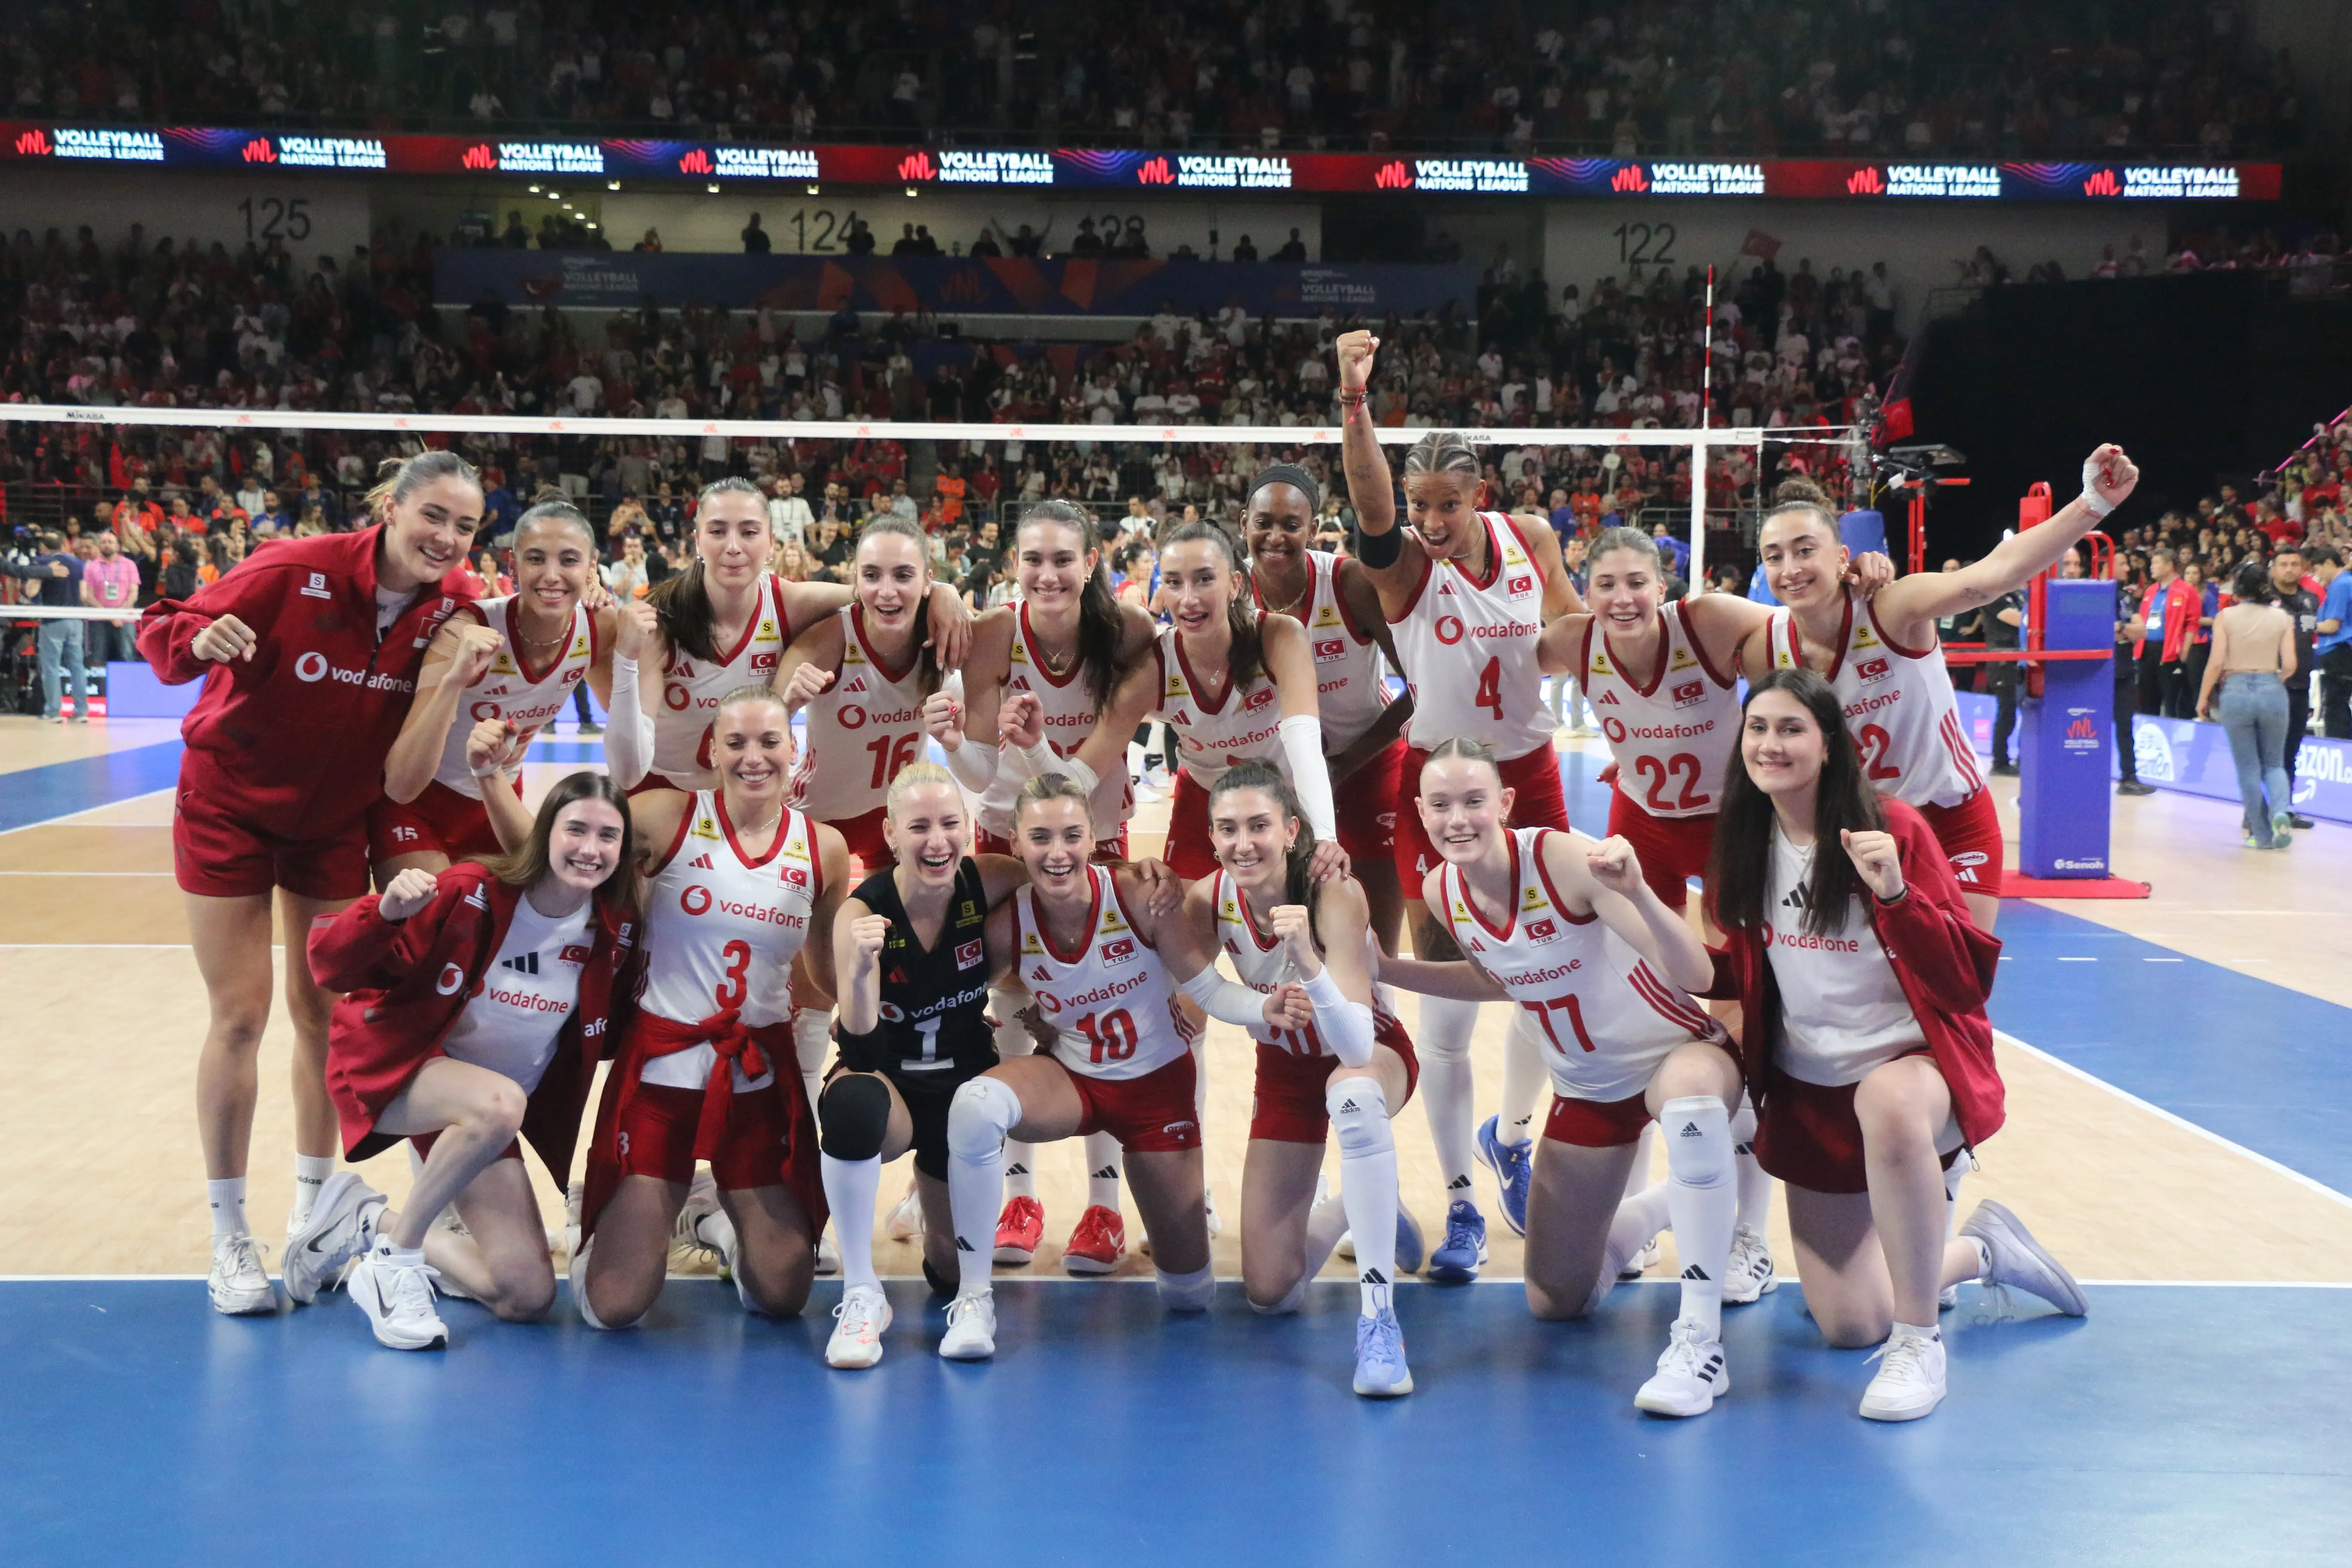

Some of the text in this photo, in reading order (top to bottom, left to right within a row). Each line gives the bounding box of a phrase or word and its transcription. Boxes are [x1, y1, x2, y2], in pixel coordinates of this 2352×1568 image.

[55, 129, 163, 148] VOLLEYBALL
[55, 145, 164, 160] NATIONS LEAGUE
[279, 138, 385, 156] VOLLEYBALL
[499, 144, 603, 161] VOLLEYBALL
[279, 152, 386, 168] NATIONS LEAGUE
[499, 158, 603, 172] NATIONS LEAGUE
[716, 149, 818, 166] VOLLEYBALL
[940, 152, 1053, 170] VOLLEYBALL
[1179, 156, 1291, 175] VOLLEYBALL
[716, 163, 818, 178] NATIONS LEAGUE
[939, 168, 1054, 183] NATIONS LEAGUE
[1416, 160, 1528, 178] VOLLEYBALL
[1652, 164, 1764, 181] VOLLEYBALL
[1888, 166, 2000, 184] VOLLEYBALL
[2125, 168, 2238, 184] VOLLEYBALL
[1178, 173, 1291, 187] NATIONS LEAGUE
[1415, 177, 1528, 191] NATIONS LEAGUE
[1651, 180, 1764, 194] NATIONS LEAGUE
[1886, 182, 2000, 196] NATIONS LEAGUE
[2123, 184, 2238, 197] NATIONS LEAGUE
[239, 197, 310, 241] 125
[790, 209, 857, 251] 124
[1613, 224, 1675, 263] 122
[314, 577, 322, 585] S
[1323, 609, 1329, 617] S
[763, 623, 770, 631] S
[1469, 621, 1537, 638] vodafone
[1859, 629, 1867, 637] S
[851, 646, 856, 654] S
[1678, 650, 1684, 659] S
[500, 655, 507, 664] S
[1868, 674, 1885, 682] TUR
[1476, 656, 1504, 720] 4
[1254, 703, 1269, 712] TUR
[1681, 697, 1699, 705] TUR
[1843, 690, 1901, 718] dafone
[507, 704, 560, 719] vodafo
[872, 707, 923, 723] vodaf
[1044, 712, 1096, 726] odafo
[1630, 720, 1714, 738] vodafone
[1850, 723, 1900, 781] 2
[867, 732, 919, 789] 16
[1635, 753, 1711, 809] 22
[704, 821, 711, 829] S
[393, 826, 418, 841] 15
[1167, 840, 1175, 861] 7
[1416, 853, 1428, 876] 4
[2065, 860, 2104, 869] Senoh
[1528, 890, 1535, 898] S
[720, 899, 803, 929] vodafone
[964, 904, 971, 913] S
[1228, 903, 1234, 911] S
[1458, 903, 1464, 912] S
[1108, 913, 1115, 922] S
[1029, 936, 1036, 944] S
[1536, 936, 1553, 944] TUR
[1778, 932, 1859, 952] vodafone
[965, 959, 978, 967] TUR
[716, 939, 751, 1009] 3
[1504, 959, 1582, 986] vodafone
[1064, 971, 1147, 1007] vodafone
[490, 988, 568, 1013] vodafone
[1520, 993, 1596, 1054] 77
[1076, 1008, 1138, 1063] 10
[619, 1132, 628, 1155] 3
